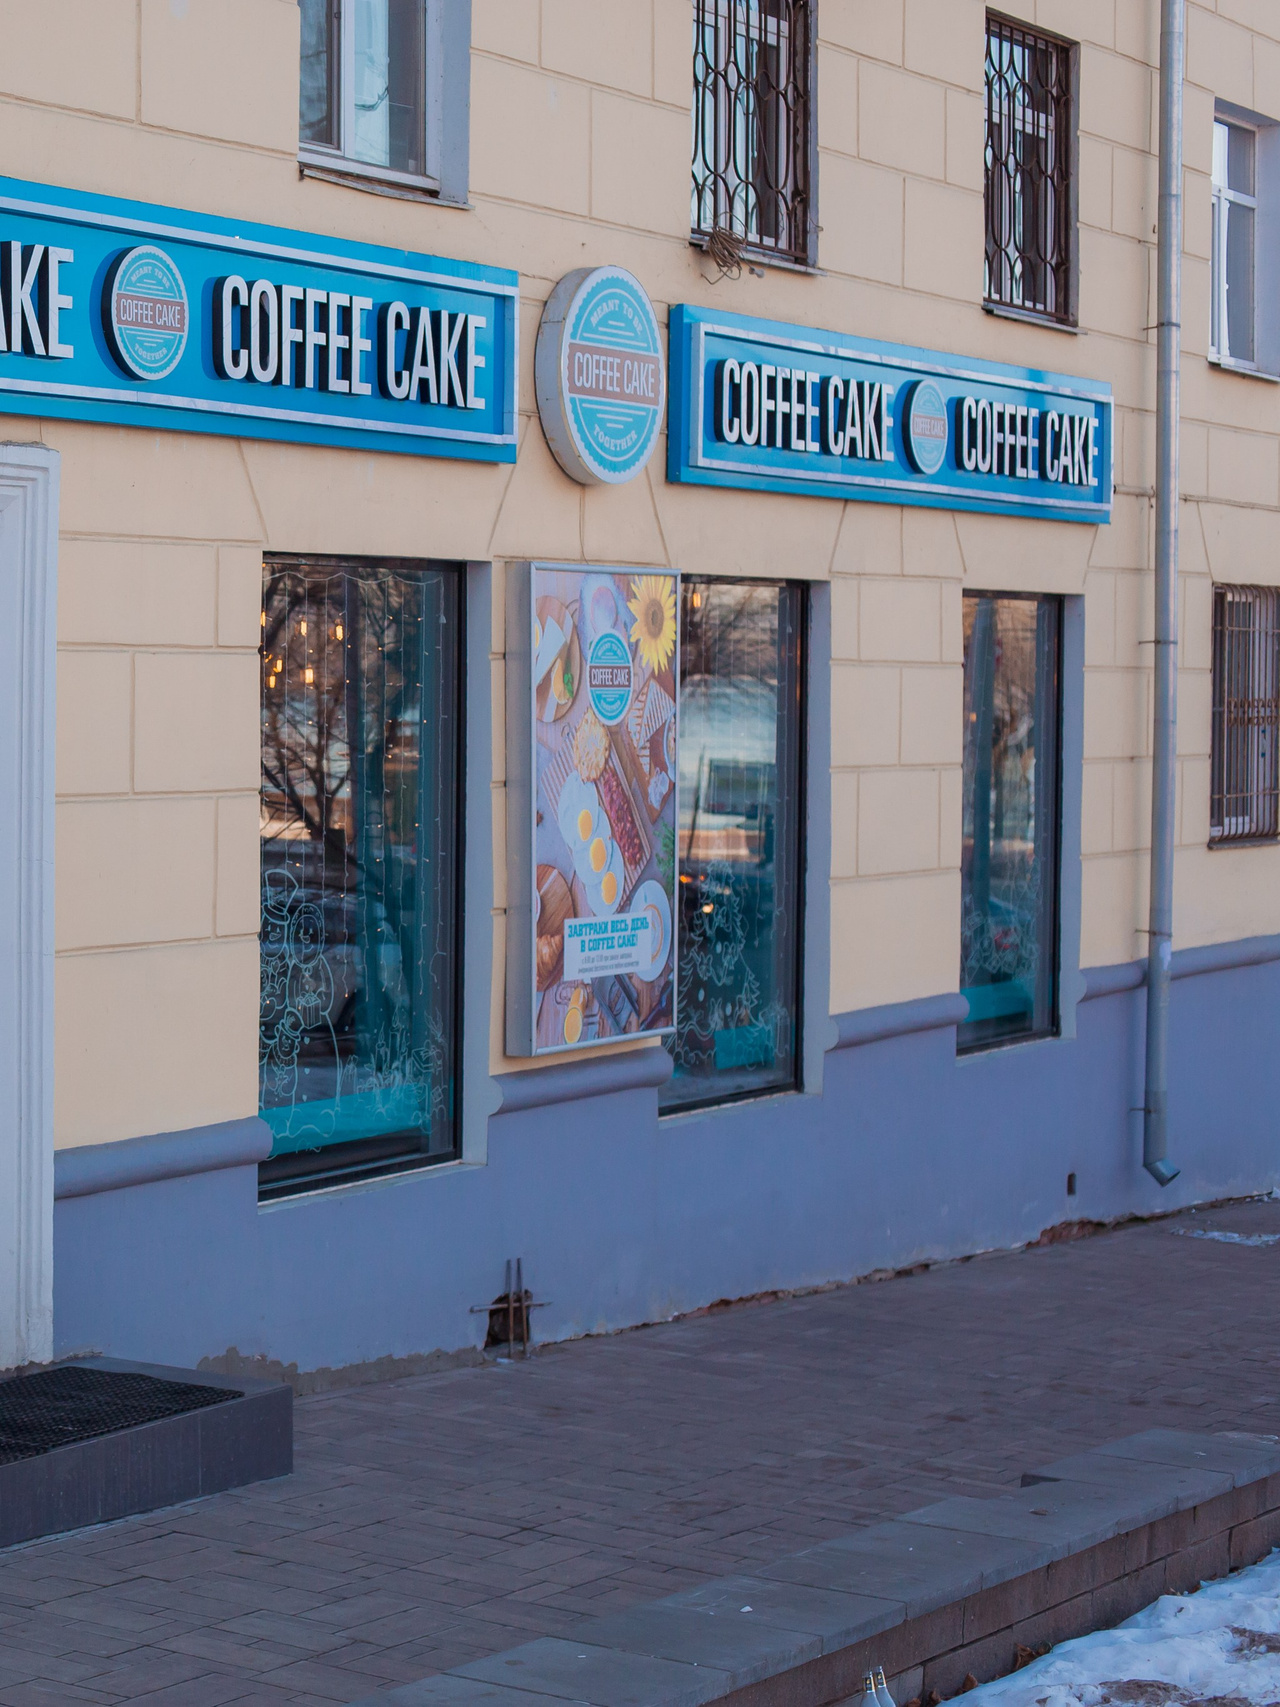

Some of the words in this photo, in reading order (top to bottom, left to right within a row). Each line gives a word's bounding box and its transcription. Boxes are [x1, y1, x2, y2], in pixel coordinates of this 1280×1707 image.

[131, 266, 152, 283] MEANT
[154, 268, 163, 279] TO
[120, 298, 153, 324] COFFEE
[155, 303, 181, 328] CAKE
[590, 299, 619, 328] MEANT
[622, 302, 634, 320] TO
[632, 315, 643, 335] BE
[135, 343, 168, 361] TOGETHER
[213, 274, 373, 396] COFFEE
[378, 300, 487, 410] CAKE
[574, 351, 620, 393] COFFEE
[623, 359, 655, 398] CAKE
[714, 357, 820, 453] COFFEE
[821, 375, 895, 462] CAKE
[593, 424, 638, 451] TOGETHER
[955, 396, 1039, 479] COFFEE
[1039, 410, 1099, 487] CAKE
[591, 668, 612, 685] COFFEE
[613, 668, 629, 686] CAKE
[568, 921, 609, 938] ЗАВТРАКИ
[610, 918, 629, 933] ВЕСЬ
[630, 917, 650, 933] ДЕНЬ
[580, 939, 586, 953] В
[588, 936, 615, 952] COFFEE
